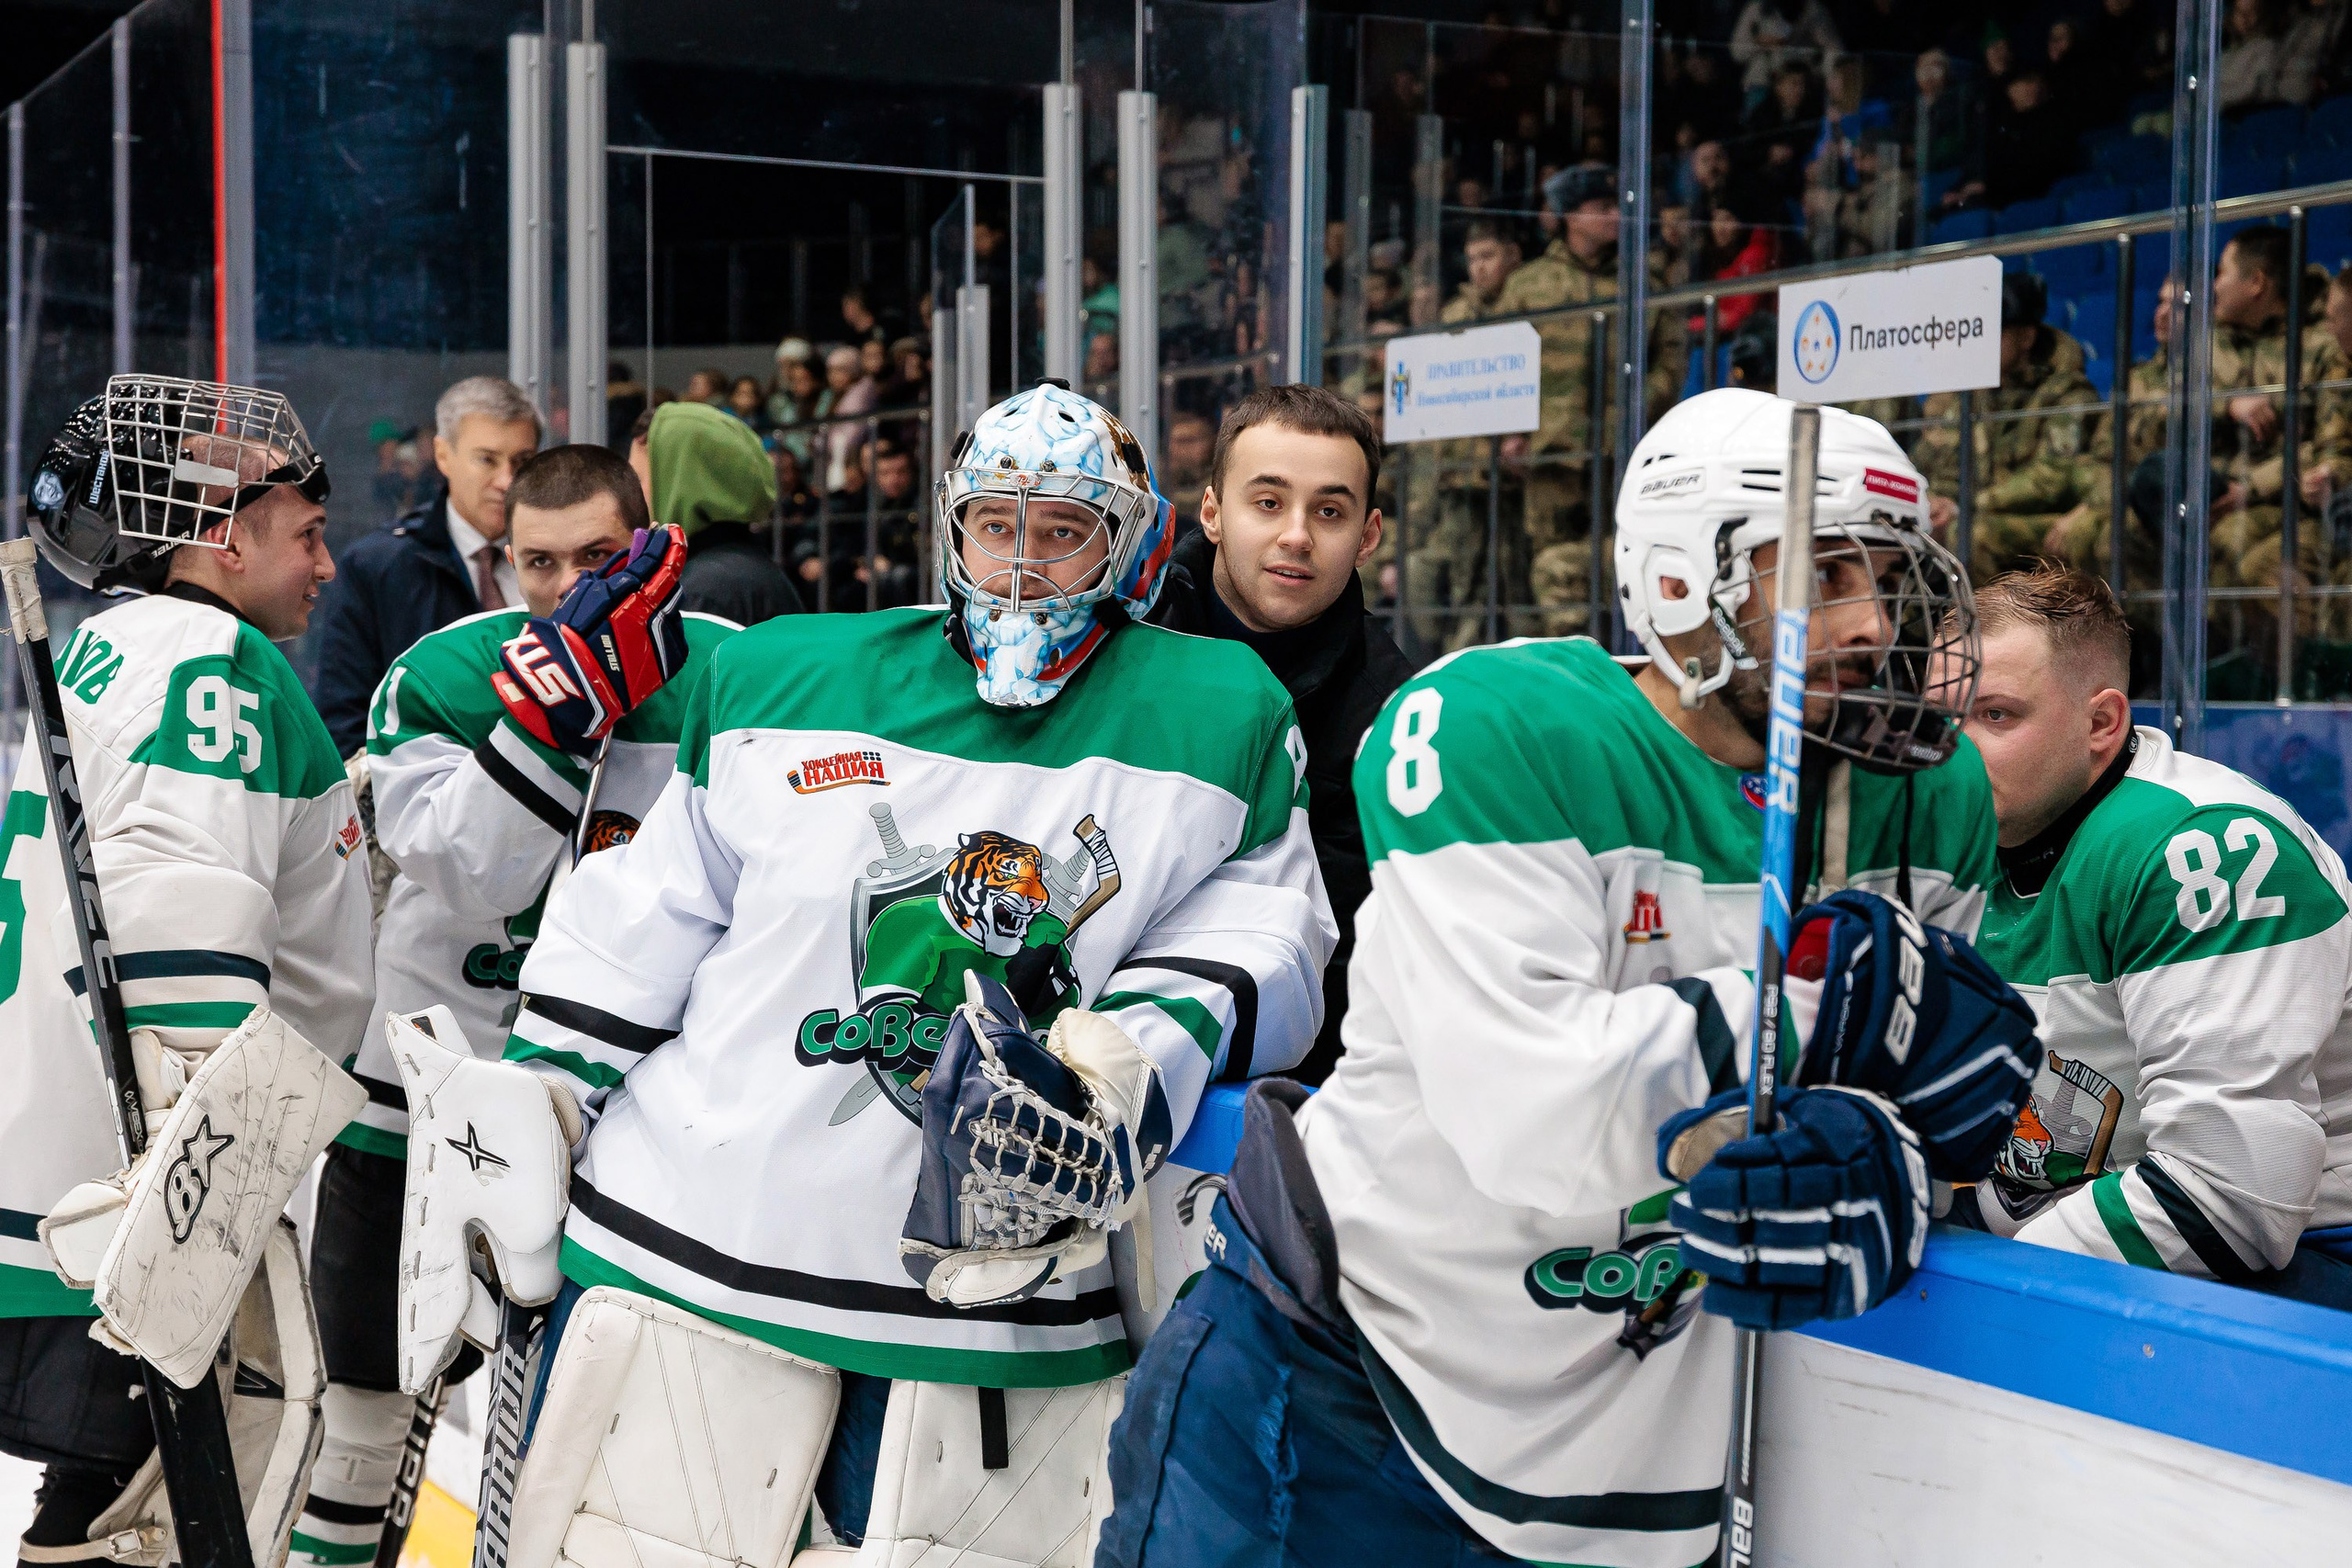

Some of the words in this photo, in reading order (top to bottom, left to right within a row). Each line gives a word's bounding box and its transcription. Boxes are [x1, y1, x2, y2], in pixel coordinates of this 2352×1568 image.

[1428, 353, 1526, 380] ПРАВИТЕЛЬСТВО
[1850, 315, 1983, 353] Платосфера
[1712, 606, 1747, 657] Reebok
[187, 675, 263, 773] 95
[1765, 606, 1809, 816] AUER
[801, 751, 863, 771] ХОККЕЙНАЯ
[803, 761, 885, 786] НАЦИЯ
[1386, 687, 1443, 818] 8
[2165, 817, 2285, 933] 82
[483, 1343, 526, 1568] ARRIOR
